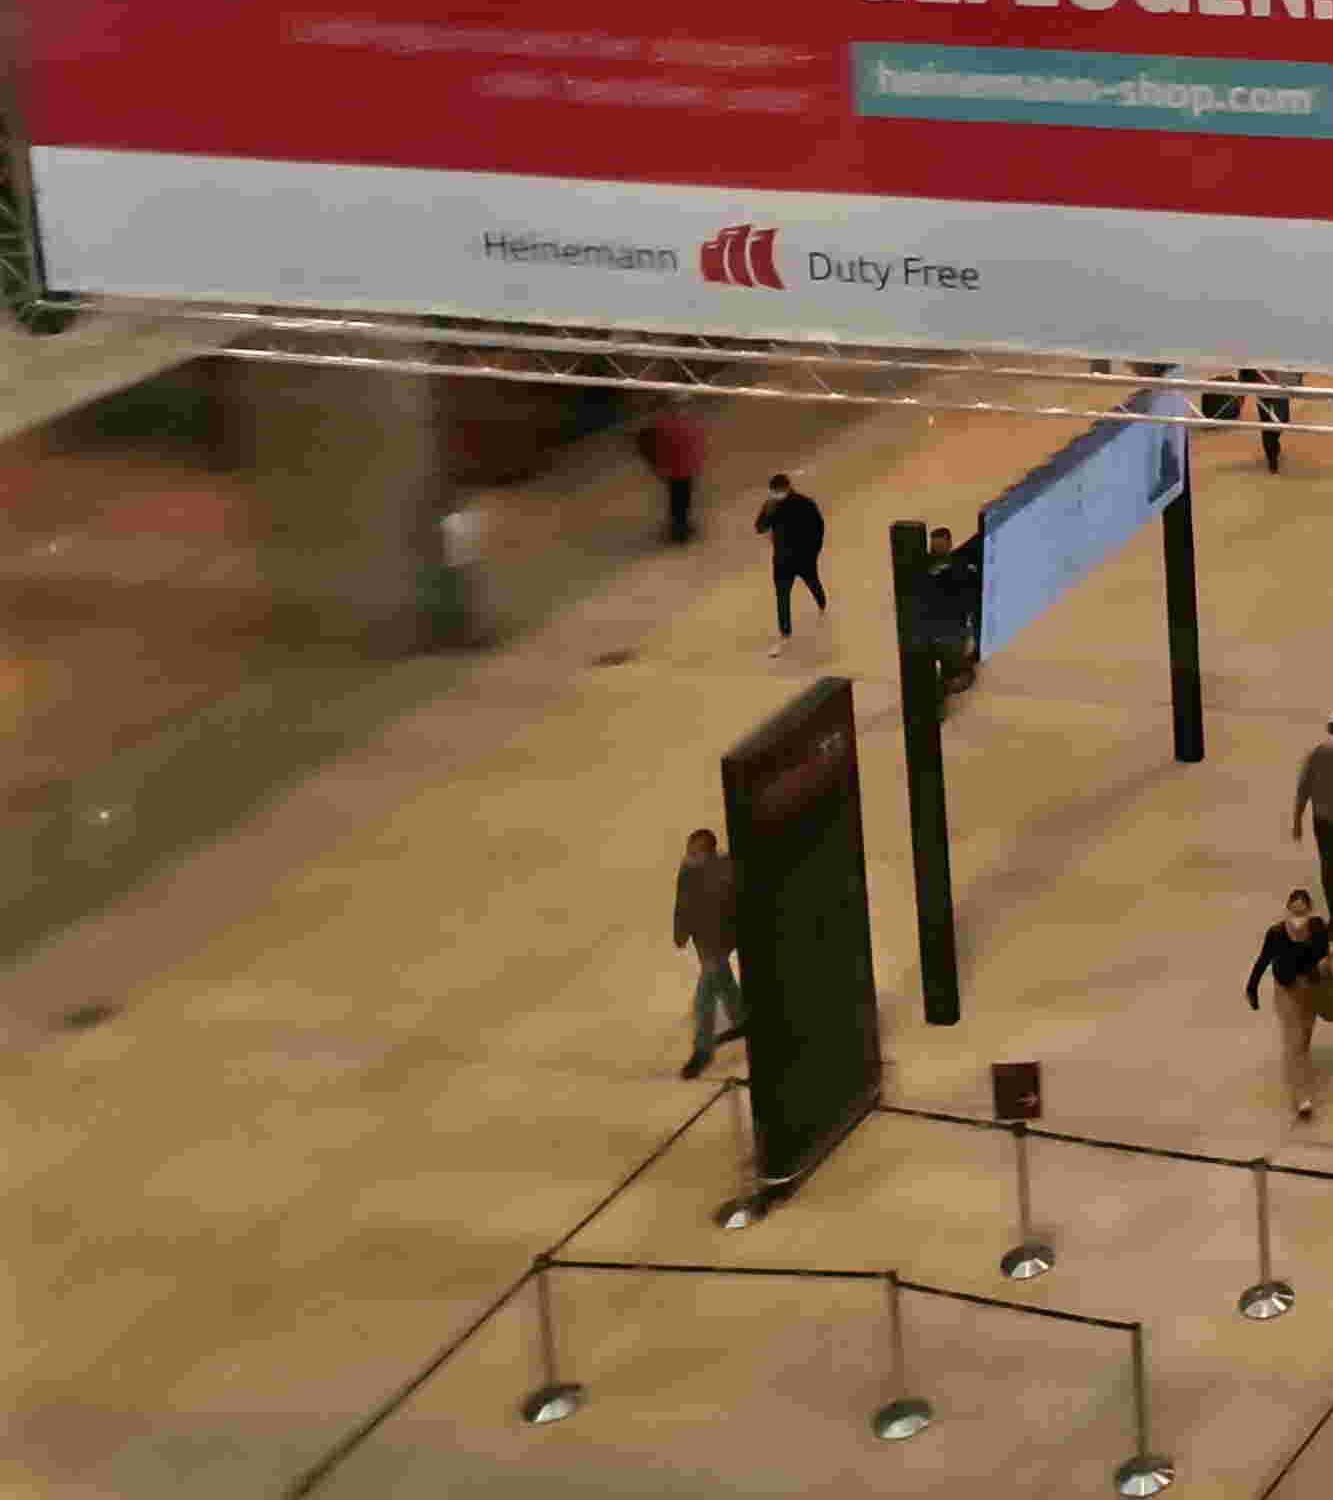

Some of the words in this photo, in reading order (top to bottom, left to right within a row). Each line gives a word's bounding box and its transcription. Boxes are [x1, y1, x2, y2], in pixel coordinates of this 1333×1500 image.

[877, 59, 1313, 117] h-shop.com
[482, 230, 678, 272] Heinemann
[807, 251, 890, 291] Duty
[903, 255, 981, 291] Free
